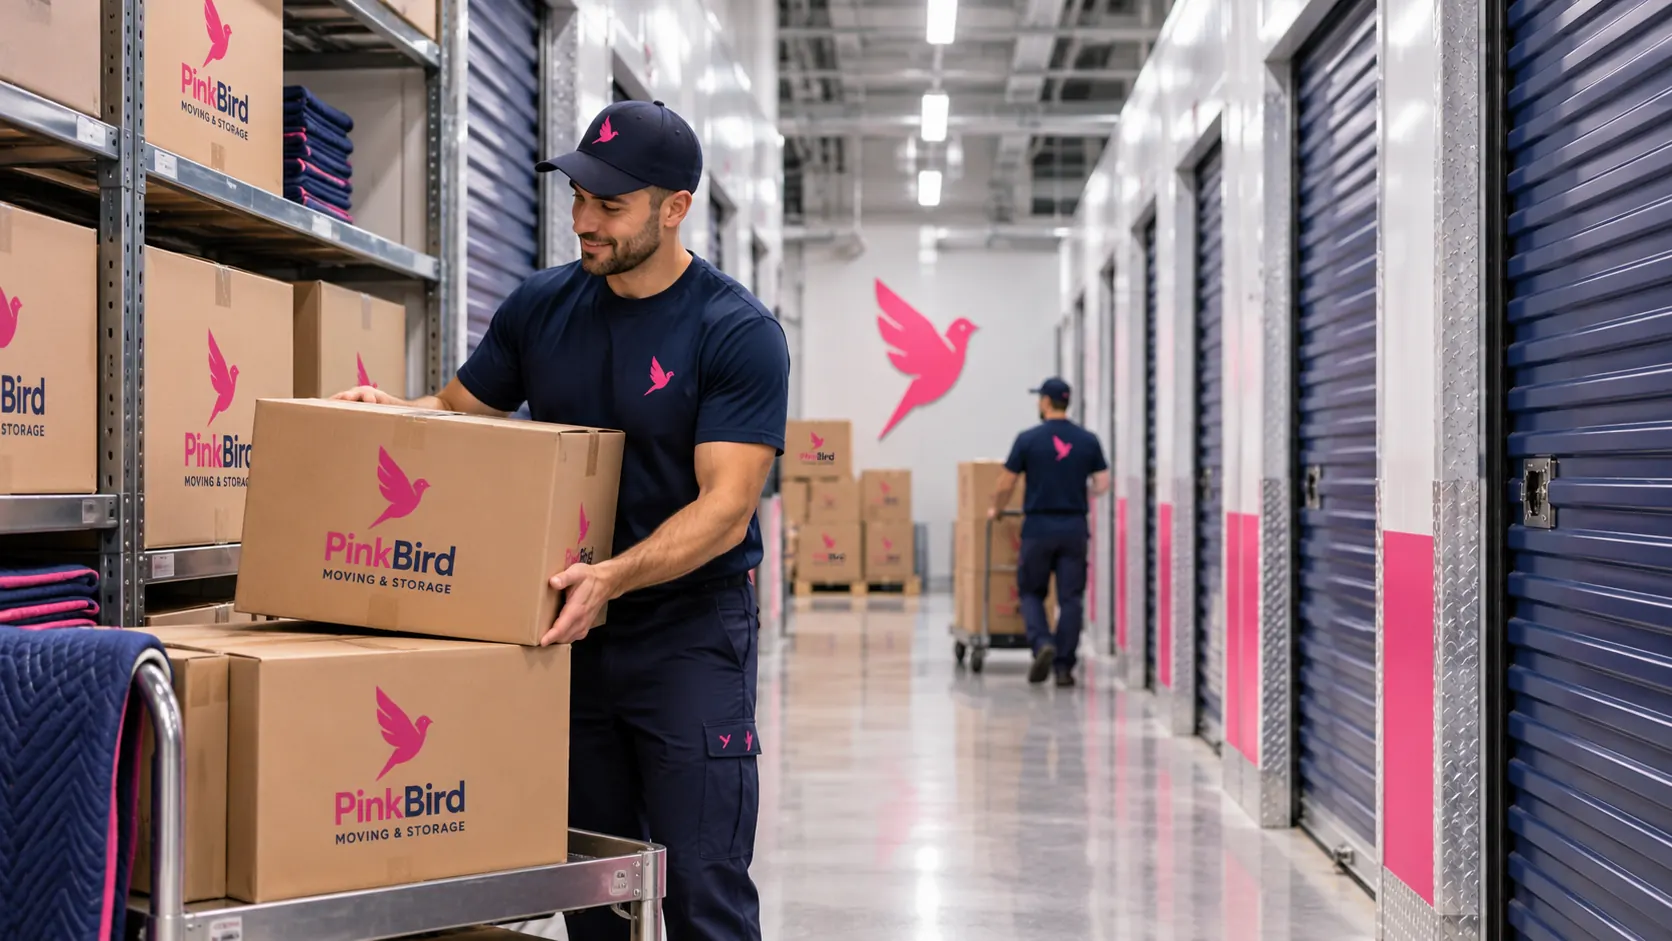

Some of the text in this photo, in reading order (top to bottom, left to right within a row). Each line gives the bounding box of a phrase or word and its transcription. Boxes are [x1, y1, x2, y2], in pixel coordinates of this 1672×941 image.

[182, 62, 248, 124] PinkBird
[211, 115, 217, 125] &
[218, 118, 249, 141] STORAGE
[1, 374, 45, 416] Bird
[1, 422, 45, 437] STORAGE
[184, 475, 249, 488] MOVING & STORA
[324, 531, 456, 577] PinkBird
[322, 568, 452, 595] MOVING & STORAGE
[335, 780, 465, 826] PinkBird
[335, 821, 465, 845] MOVING & STORAGE
